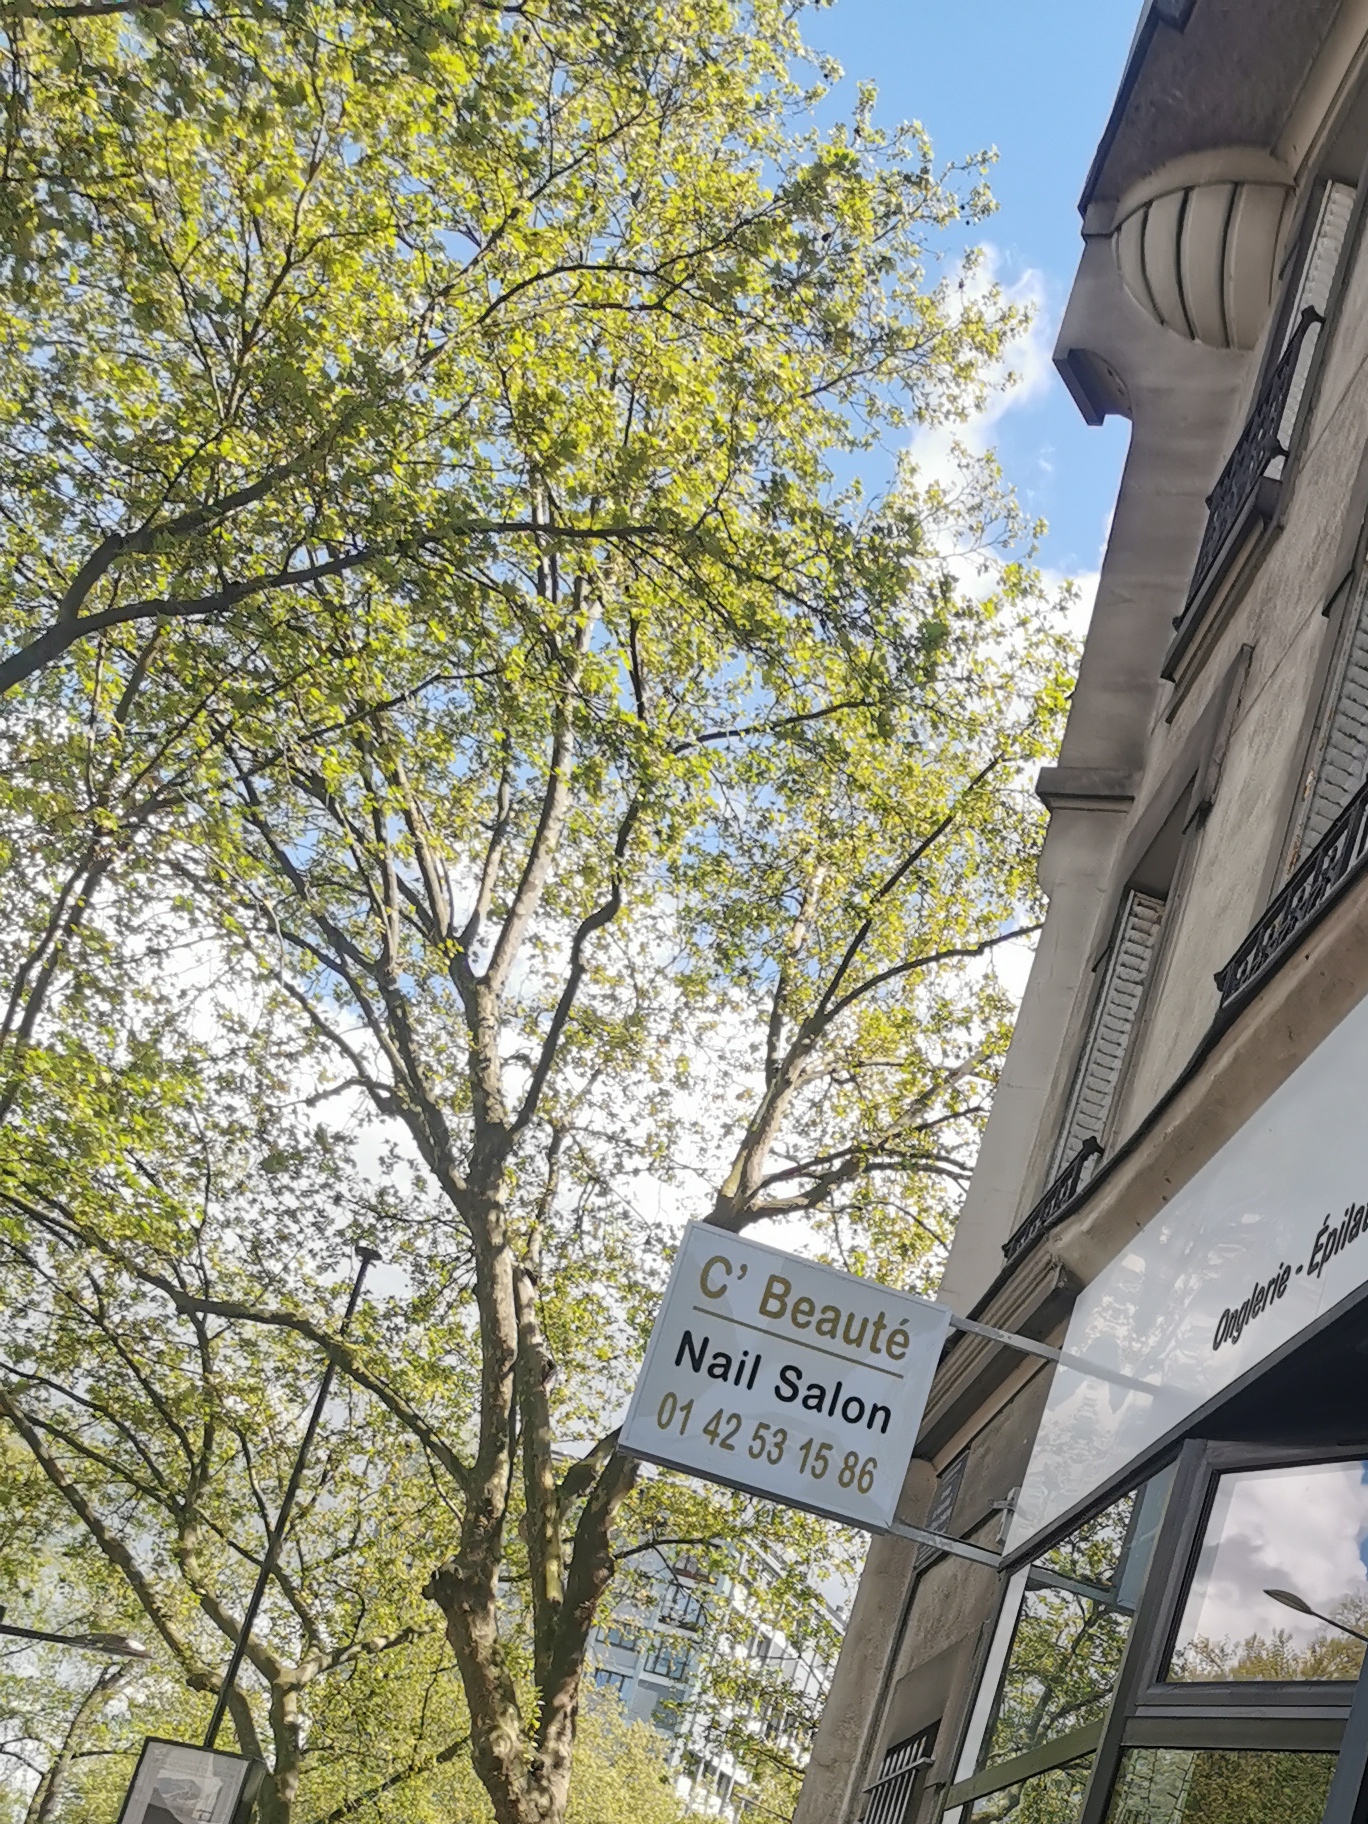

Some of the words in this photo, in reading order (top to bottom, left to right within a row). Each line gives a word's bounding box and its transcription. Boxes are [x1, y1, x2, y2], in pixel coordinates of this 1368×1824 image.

[759, 1274, 910, 1361] Beauté
[1213, 1262, 1291, 1350] Onglerie
[675, 1330, 762, 1390] Nail
[774, 1365, 892, 1434] Salon
[657, 1392, 694, 1436] 01
[703, 1408, 743, 1451] 42
[748, 1422, 788, 1465] 53
[799, 1437, 833, 1480] 15
[838, 1451, 878, 1495] 86
